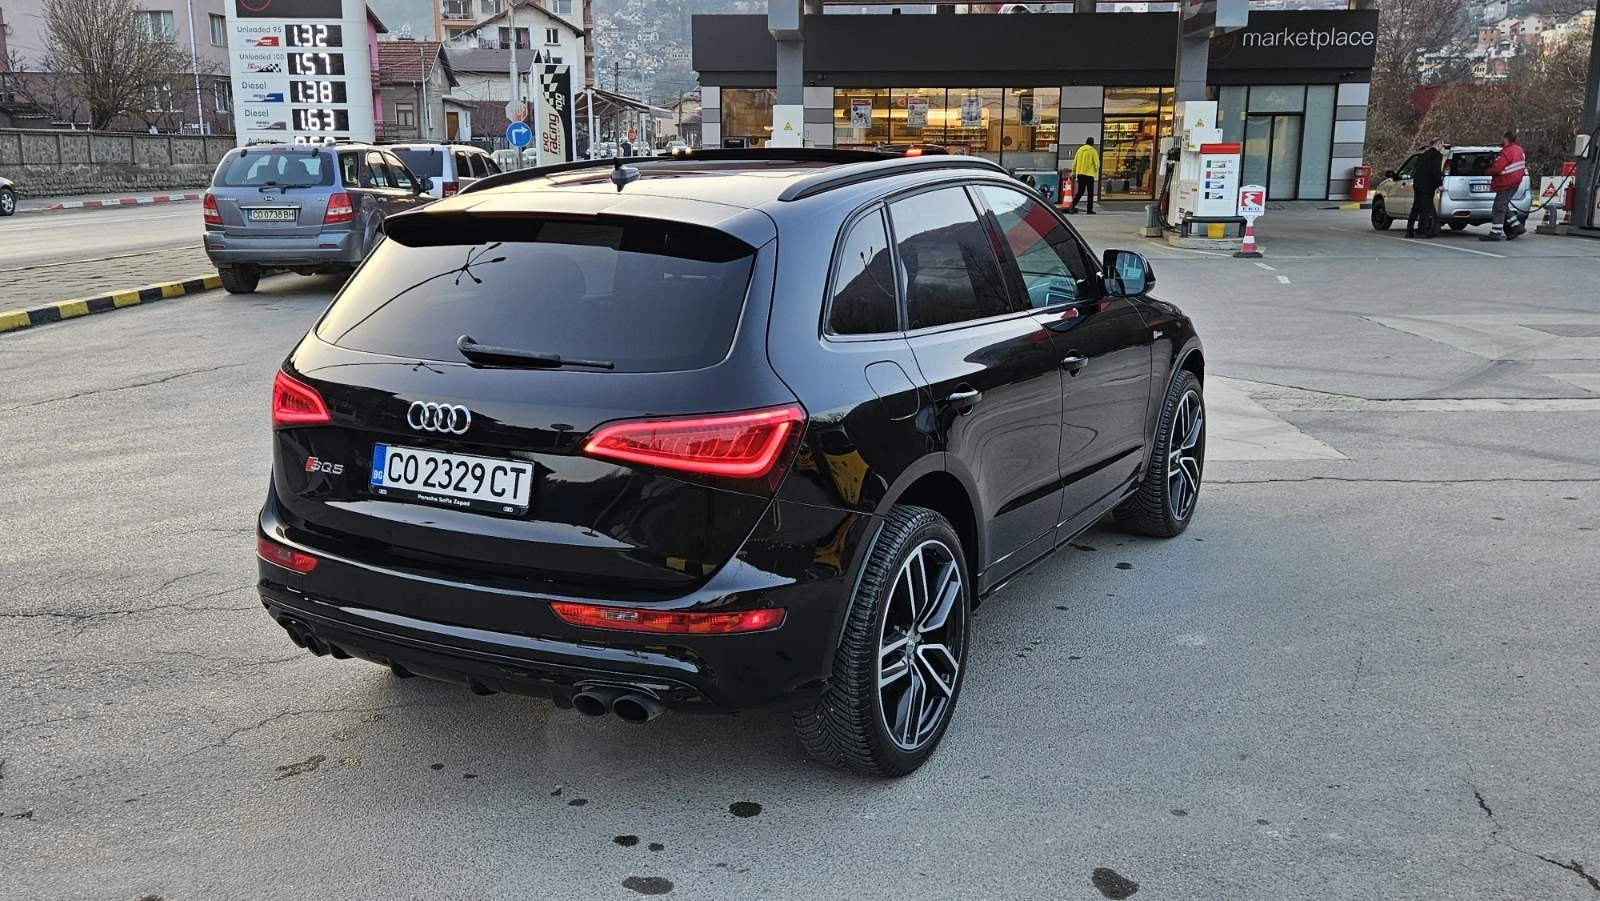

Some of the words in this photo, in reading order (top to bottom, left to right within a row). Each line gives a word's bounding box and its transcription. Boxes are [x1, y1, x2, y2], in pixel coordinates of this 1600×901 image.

[293, 24, 328, 47] 1.32
[1242, 26, 1375, 51] marketplace
[295, 53, 331, 75] 1.57
[241, 81, 267, 89] Diesel
[298, 80, 333, 103] 1.38
[244, 109, 269, 117] Diesel
[300, 108, 335, 131] 1.63
[549, 113, 560, 155] racing
[265, 210, 283, 219] 0738
[283, 210, 294, 219] BH
[308, 456, 345, 475] SQ5
[373, 470, 384, 480] BG
[422, 456, 486, 494] 2329
[490, 465, 527, 499] CT
[438, 496, 452, 504] Sofia
